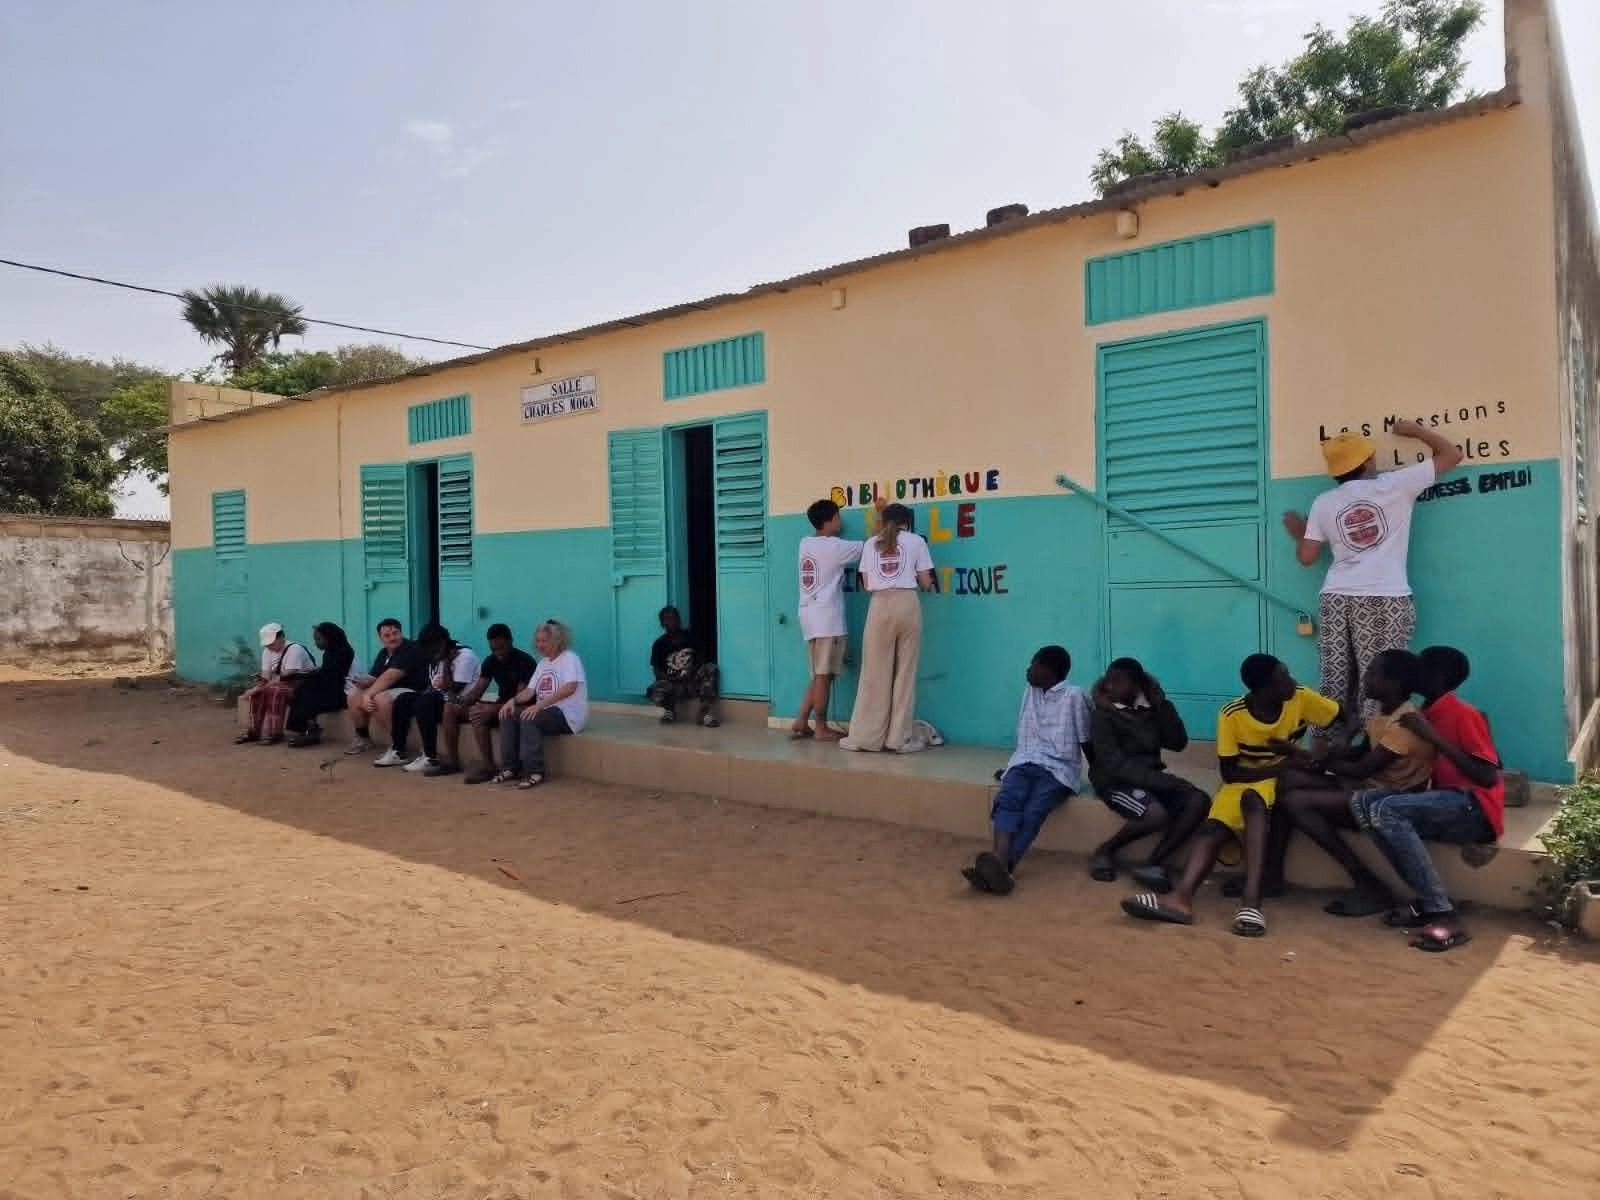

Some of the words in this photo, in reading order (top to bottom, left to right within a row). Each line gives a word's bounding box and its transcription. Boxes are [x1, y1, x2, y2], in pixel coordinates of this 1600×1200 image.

[551, 379, 582, 397] SALLE
[524, 400, 565, 419] CHARLES
[570, 395, 594, 411] MOGA
[1383, 400, 1506, 433] Mssions
[1394, 437, 1511, 466] Loles
